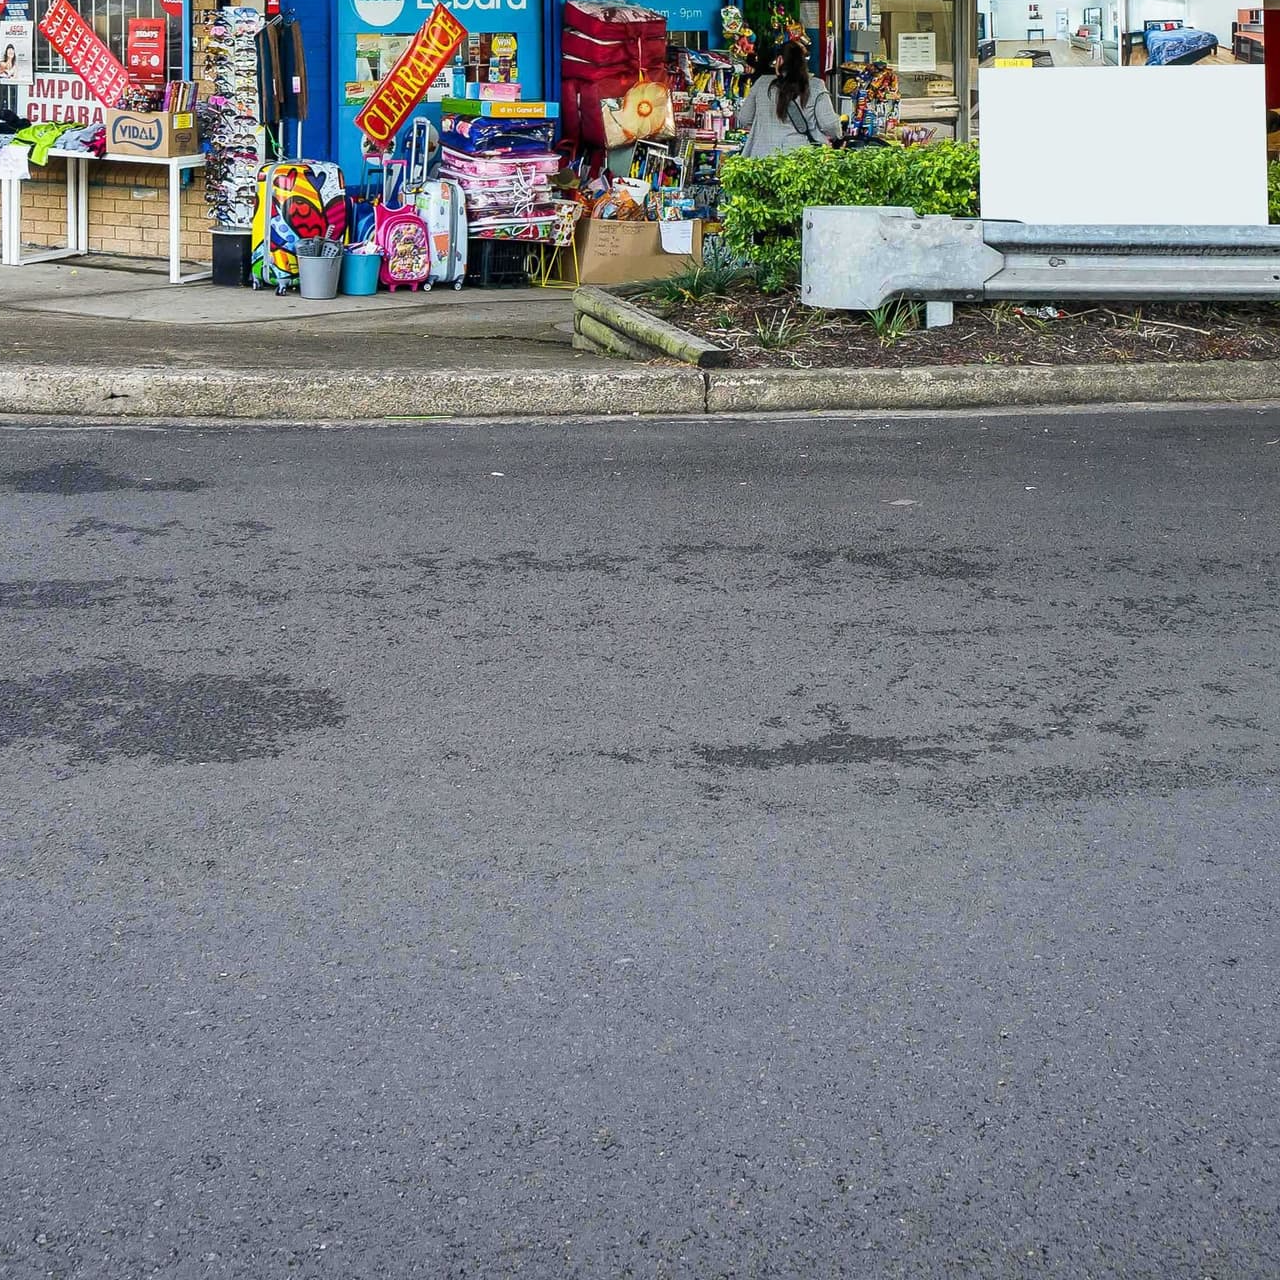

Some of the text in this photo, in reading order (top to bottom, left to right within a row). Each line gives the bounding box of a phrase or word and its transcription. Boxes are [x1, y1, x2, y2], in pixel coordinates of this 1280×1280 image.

[47, 6, 68, 36] SALE
[679, 7, 702, 20] 9pm
[55, 16, 76, 46] SALE
[63, 25, 84, 56] SALE
[72, 36, 92, 66] SALE
[80, 46, 101, 76] SALE
[88, 56, 109, 86] SALE
[97, 66, 119, 96] SALE
[363, 11, 461, 141] CLEARANCE
[106, 76, 127, 106] SALE
[120, 124, 155, 141] VIDAL
